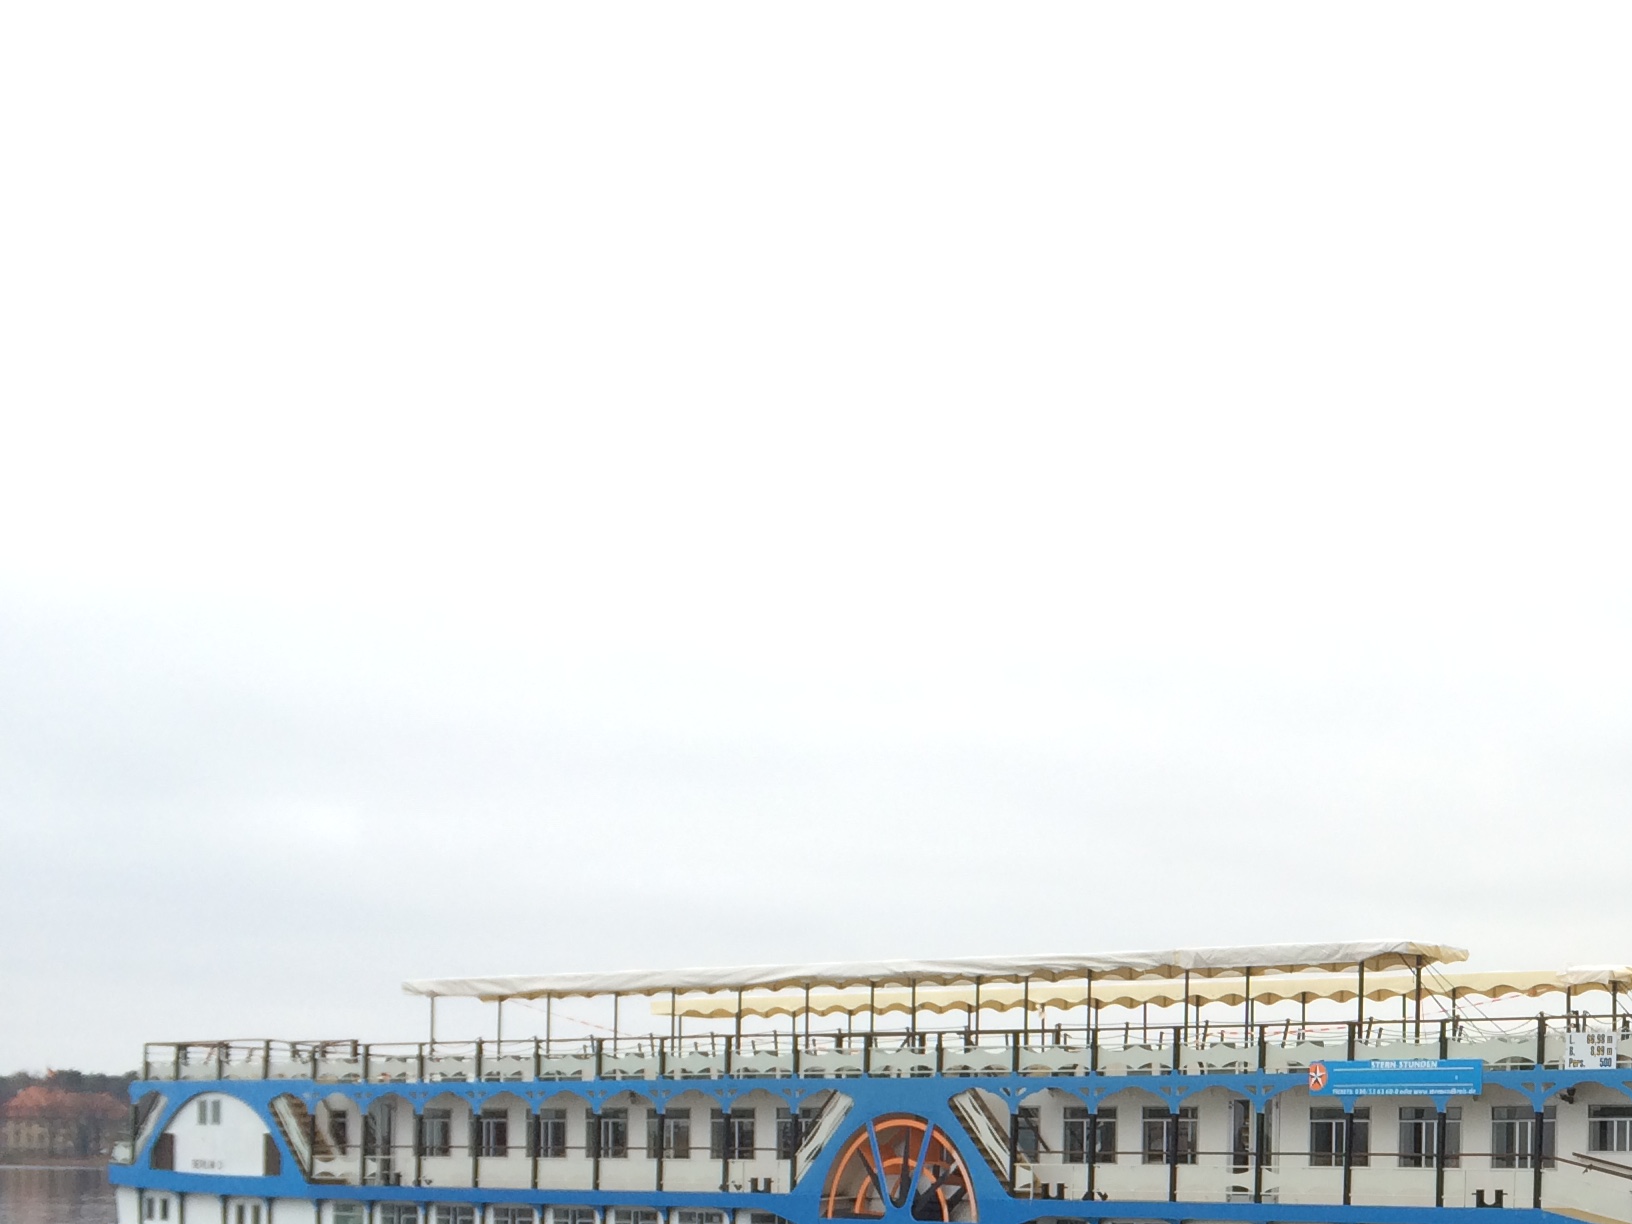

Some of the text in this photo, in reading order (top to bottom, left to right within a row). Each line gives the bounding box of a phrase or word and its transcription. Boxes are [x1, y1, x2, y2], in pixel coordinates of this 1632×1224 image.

[1607, 1047, 1613, 1055] m
[1569, 1057, 1612, 1068] Pers. 500
